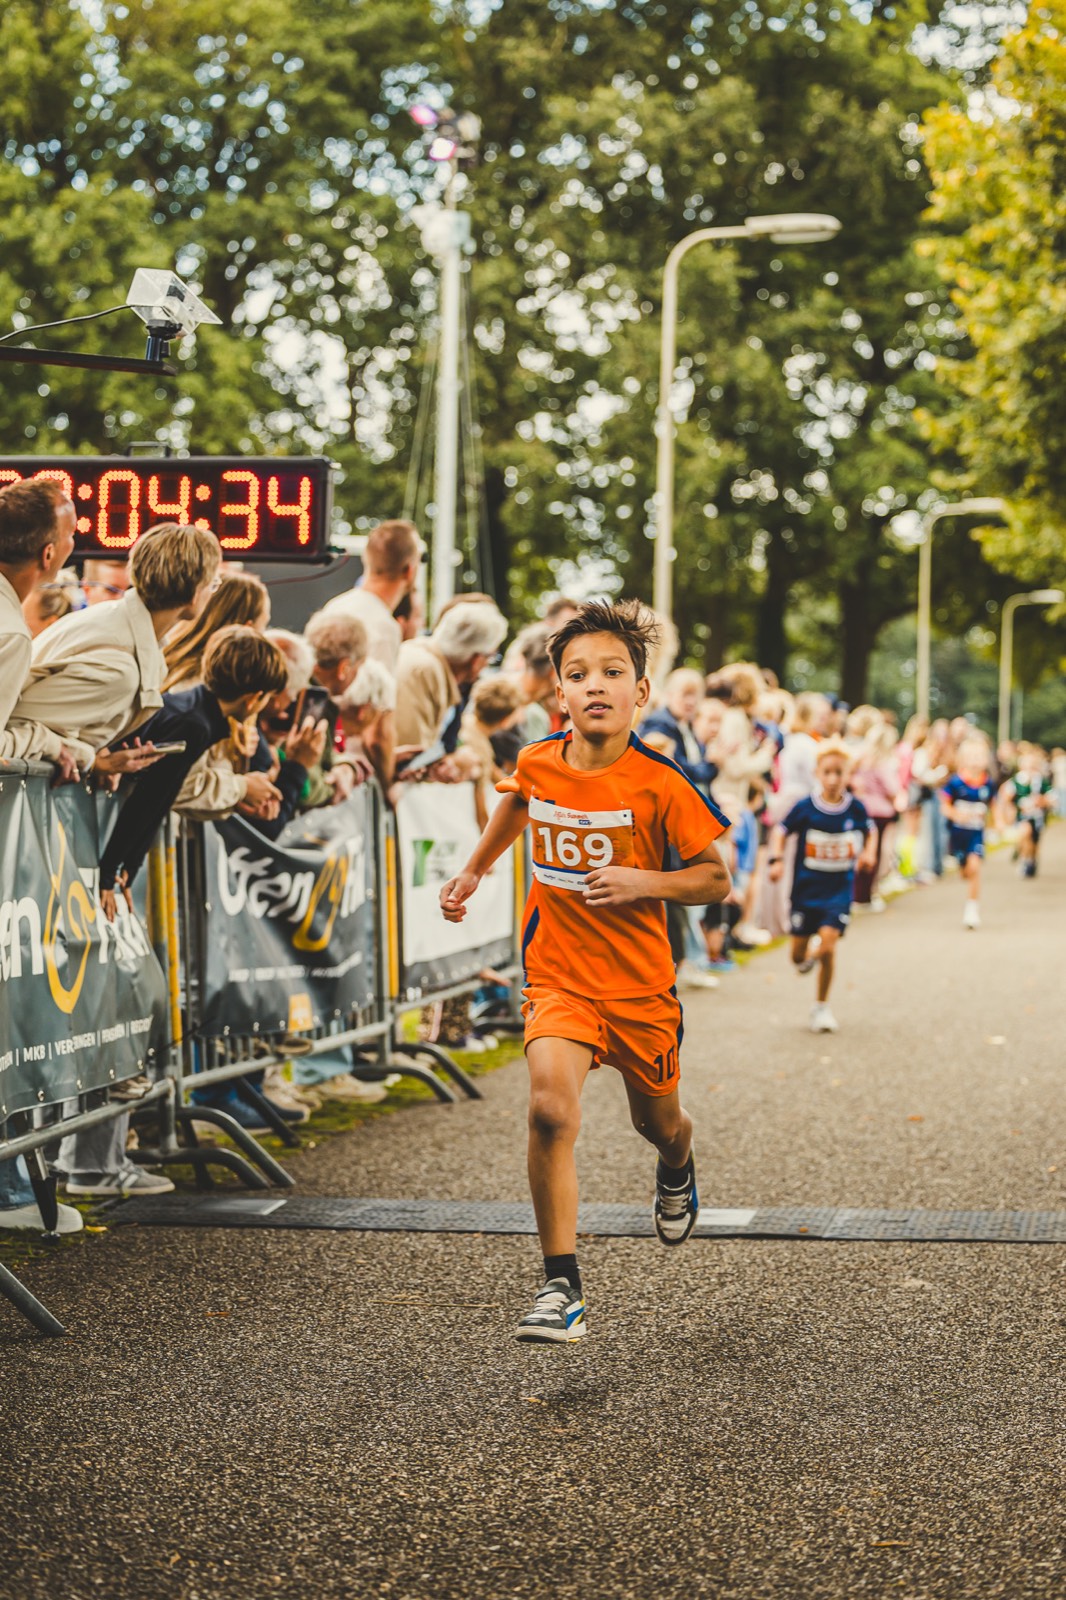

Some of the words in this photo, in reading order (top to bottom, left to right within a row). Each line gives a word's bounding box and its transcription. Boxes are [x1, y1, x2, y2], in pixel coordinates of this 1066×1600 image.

[537, 826, 614, 868] 169
[23, 1044, 46, 1063] MKB
[653, 1043, 675, 1083] 10
